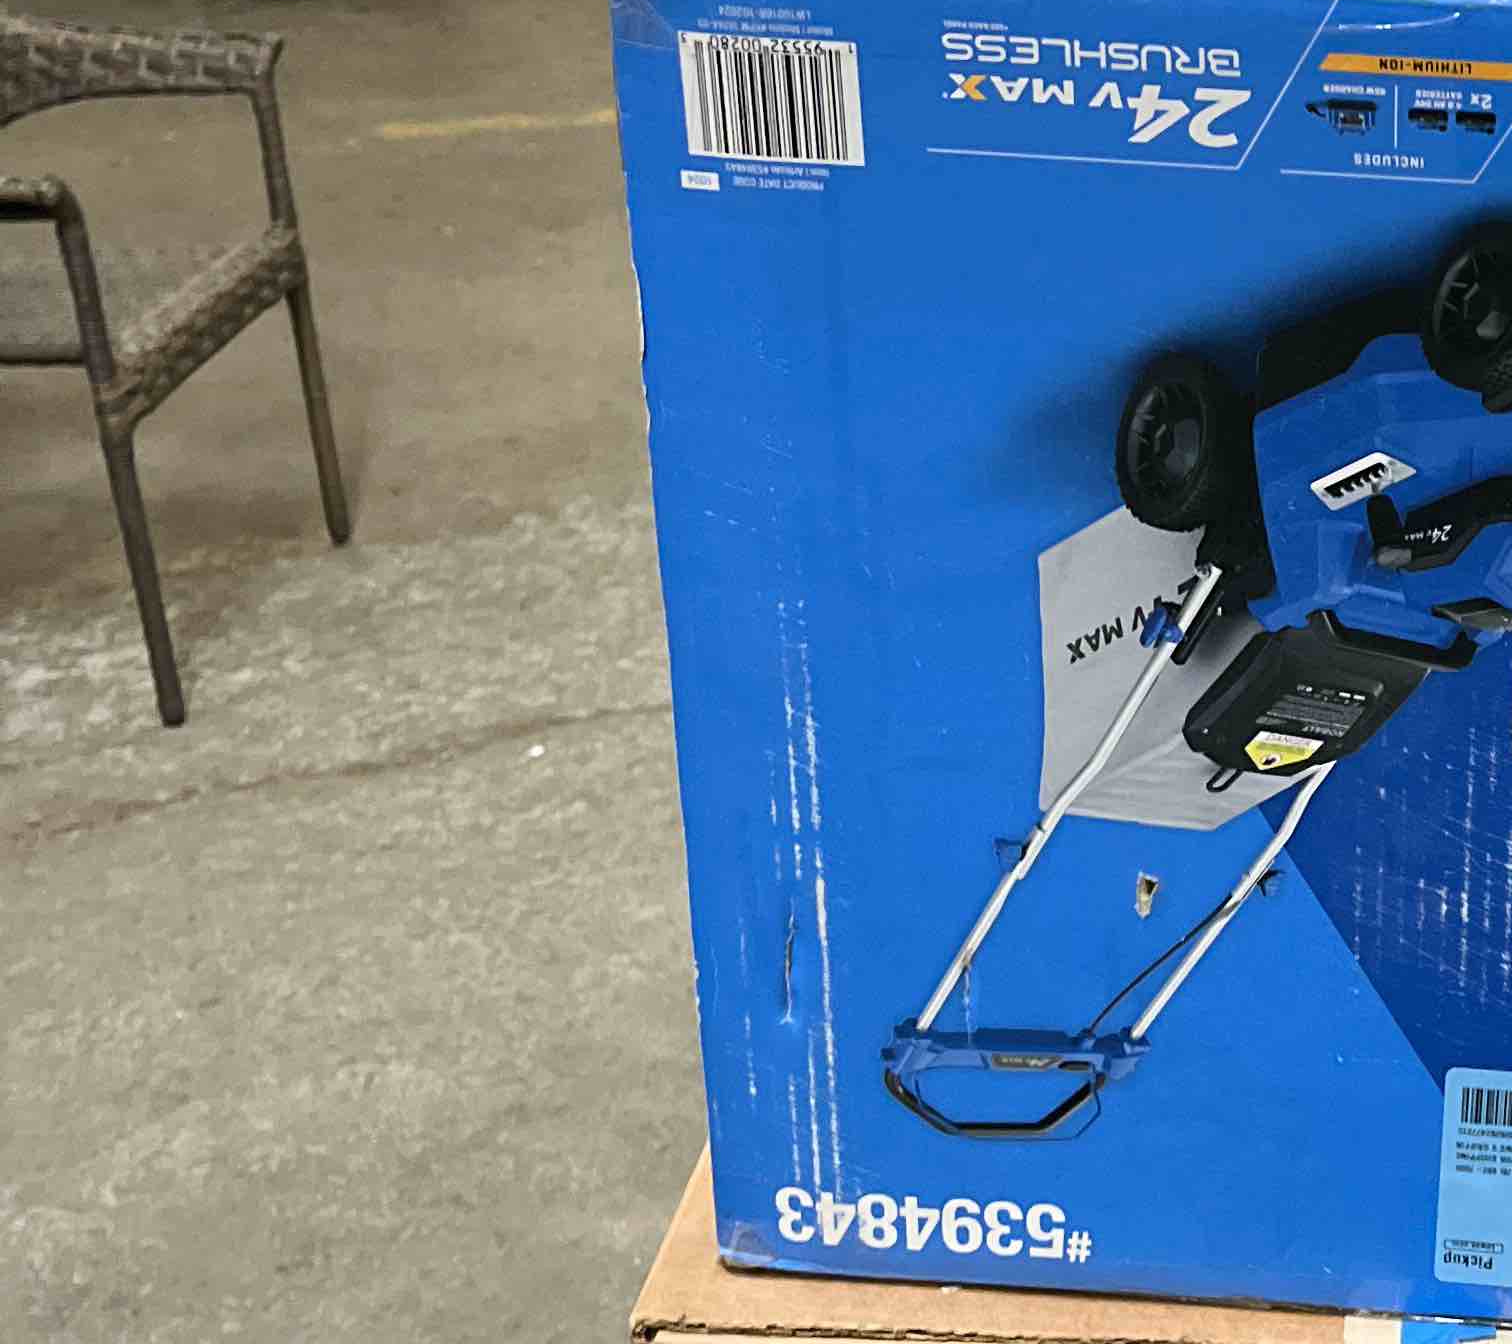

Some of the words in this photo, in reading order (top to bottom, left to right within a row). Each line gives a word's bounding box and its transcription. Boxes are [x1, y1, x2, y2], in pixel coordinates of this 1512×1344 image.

[709, 35, 762, 51] 00280
[770, 40, 824, 53] 95532
[941, 32, 1241, 77] BRUSHLESS
[1378, 58, 1472, 74] LITHIUM-ION
[1470, 92, 1492, 110] 2x
[1353, 152, 1424, 169] INCLUDES
[1066, 617, 1124, 665] MAX
[775, 1187, 1092, 1263] #5394843
[1442, 1251, 1494, 1270] Pickup
